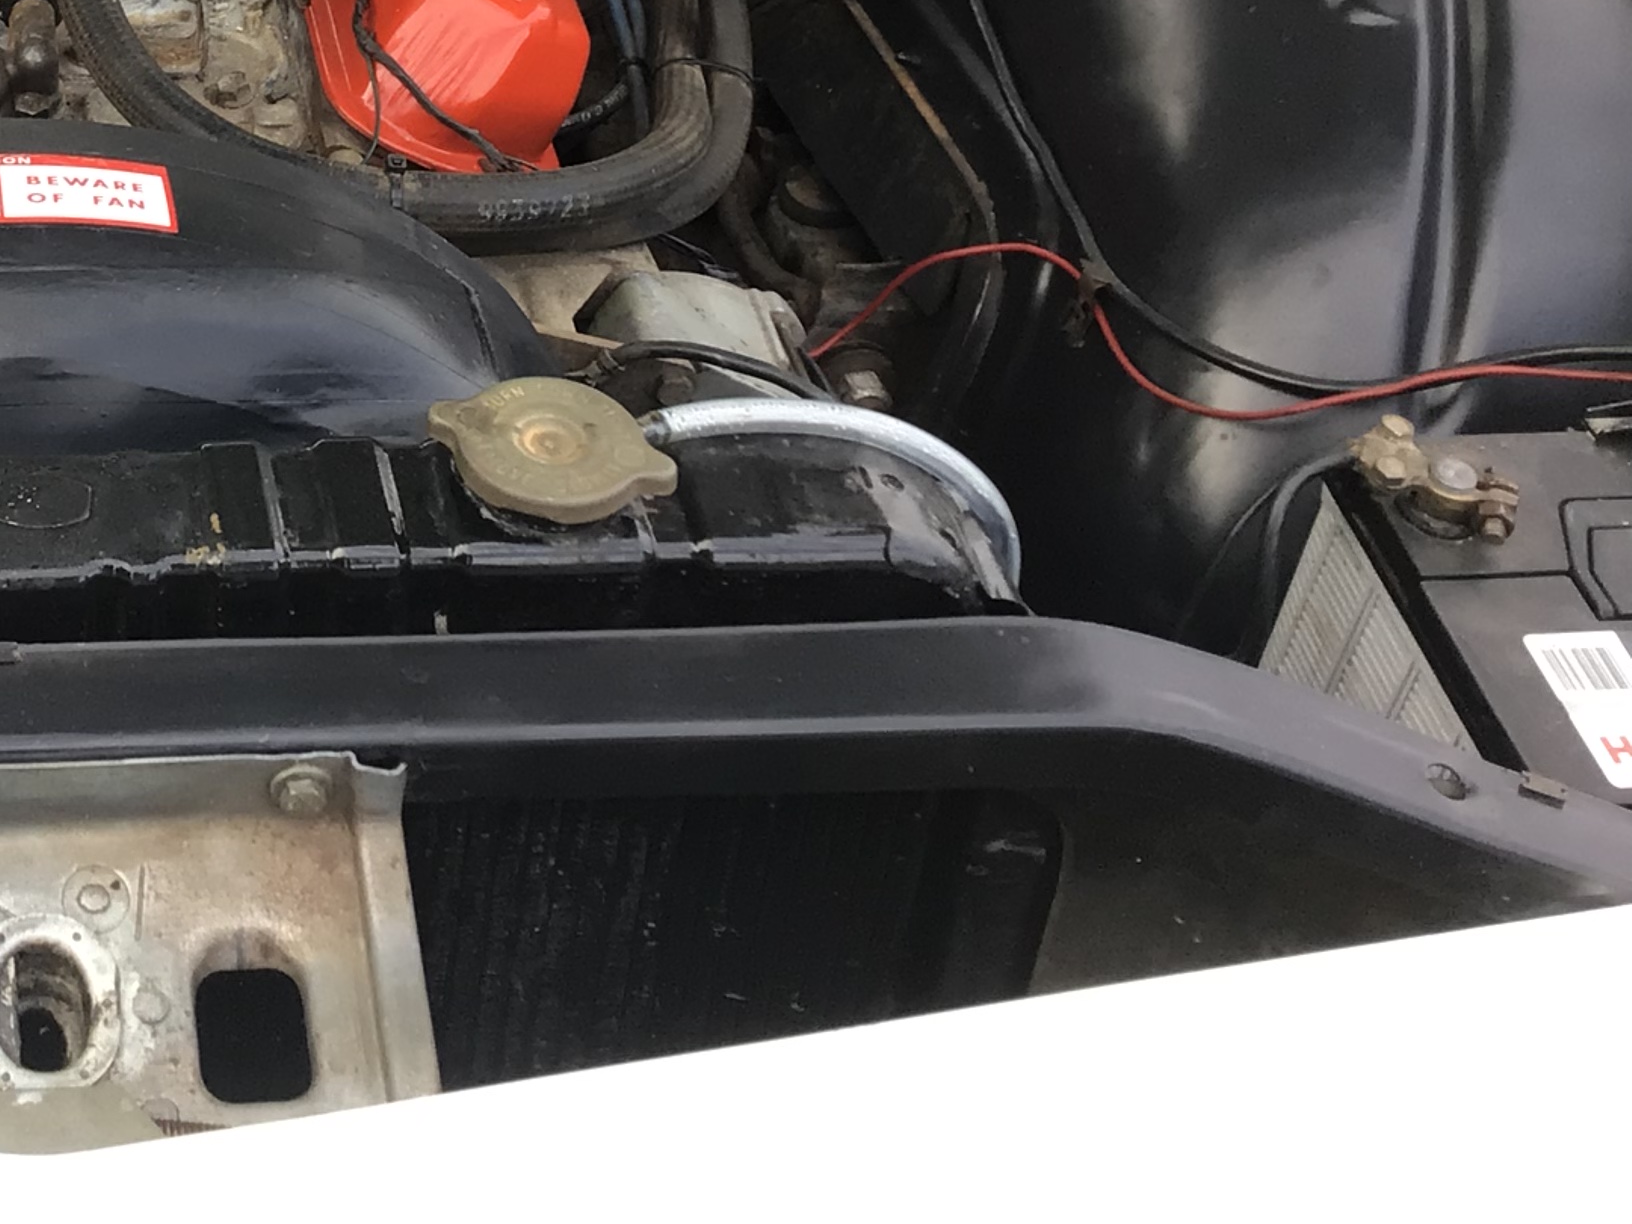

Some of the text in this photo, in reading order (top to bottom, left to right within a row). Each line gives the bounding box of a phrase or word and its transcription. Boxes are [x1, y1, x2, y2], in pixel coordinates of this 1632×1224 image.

[26, 175, 144, 193] BEWARE
[26, 192, 146, 210] OF FAN
